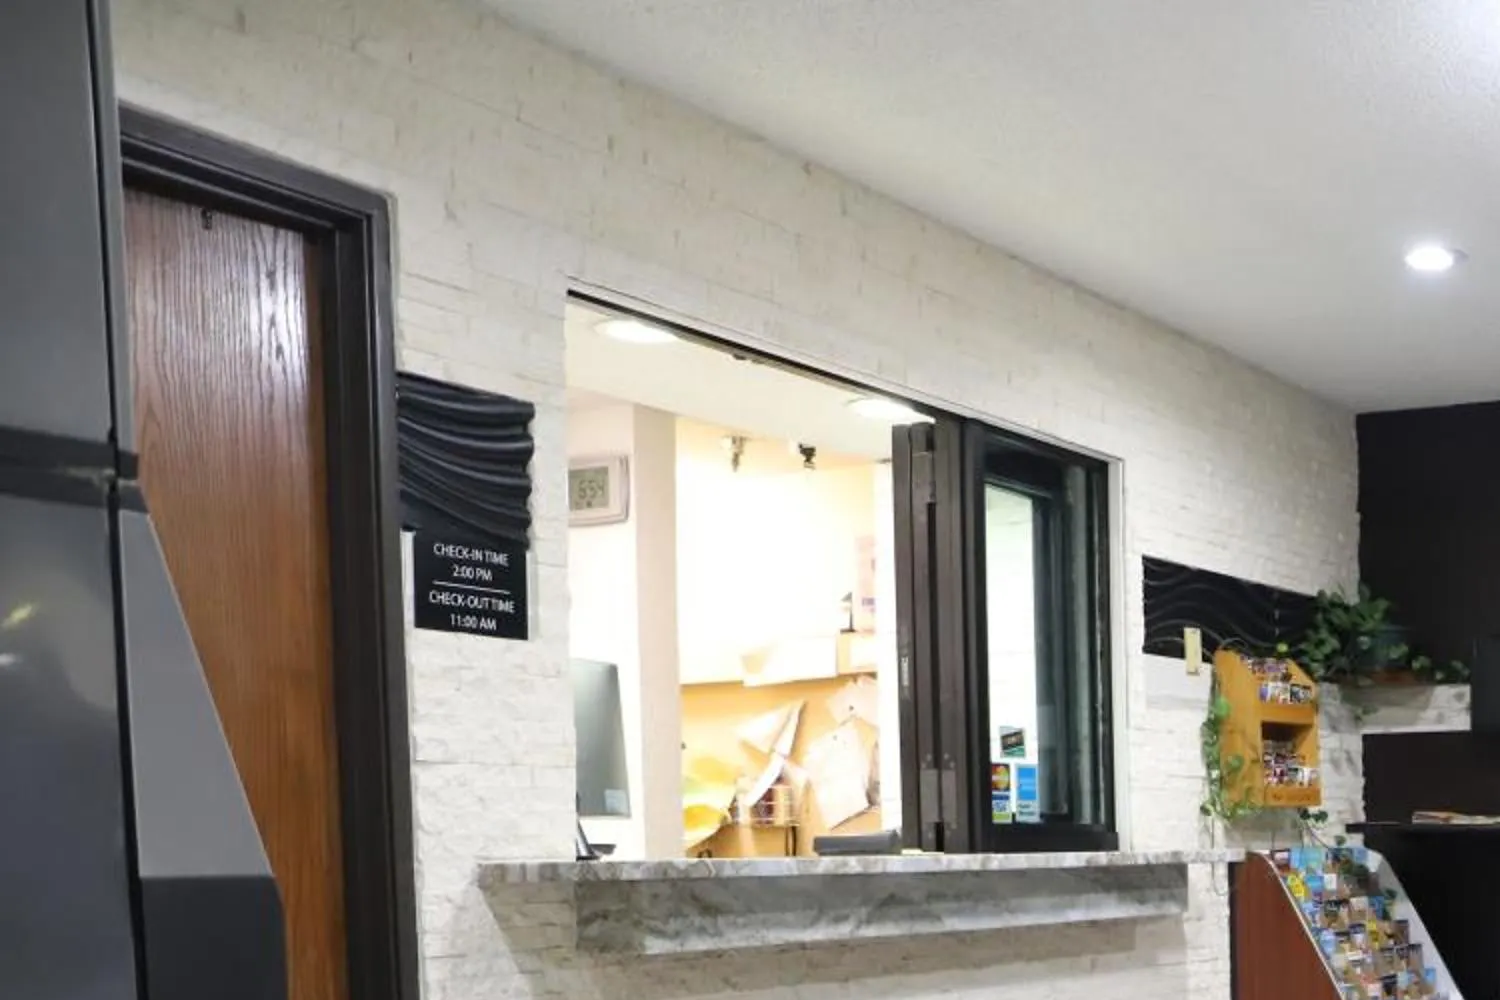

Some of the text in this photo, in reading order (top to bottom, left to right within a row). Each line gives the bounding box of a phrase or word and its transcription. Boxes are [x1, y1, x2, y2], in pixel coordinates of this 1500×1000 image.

[433, 543, 509, 567] CHECK-IN TIME
[452, 564, 493, 581] 2:00 PM
[491, 599, 515, 613] TIME
[450, 613, 497, 631] 11:00 AM
